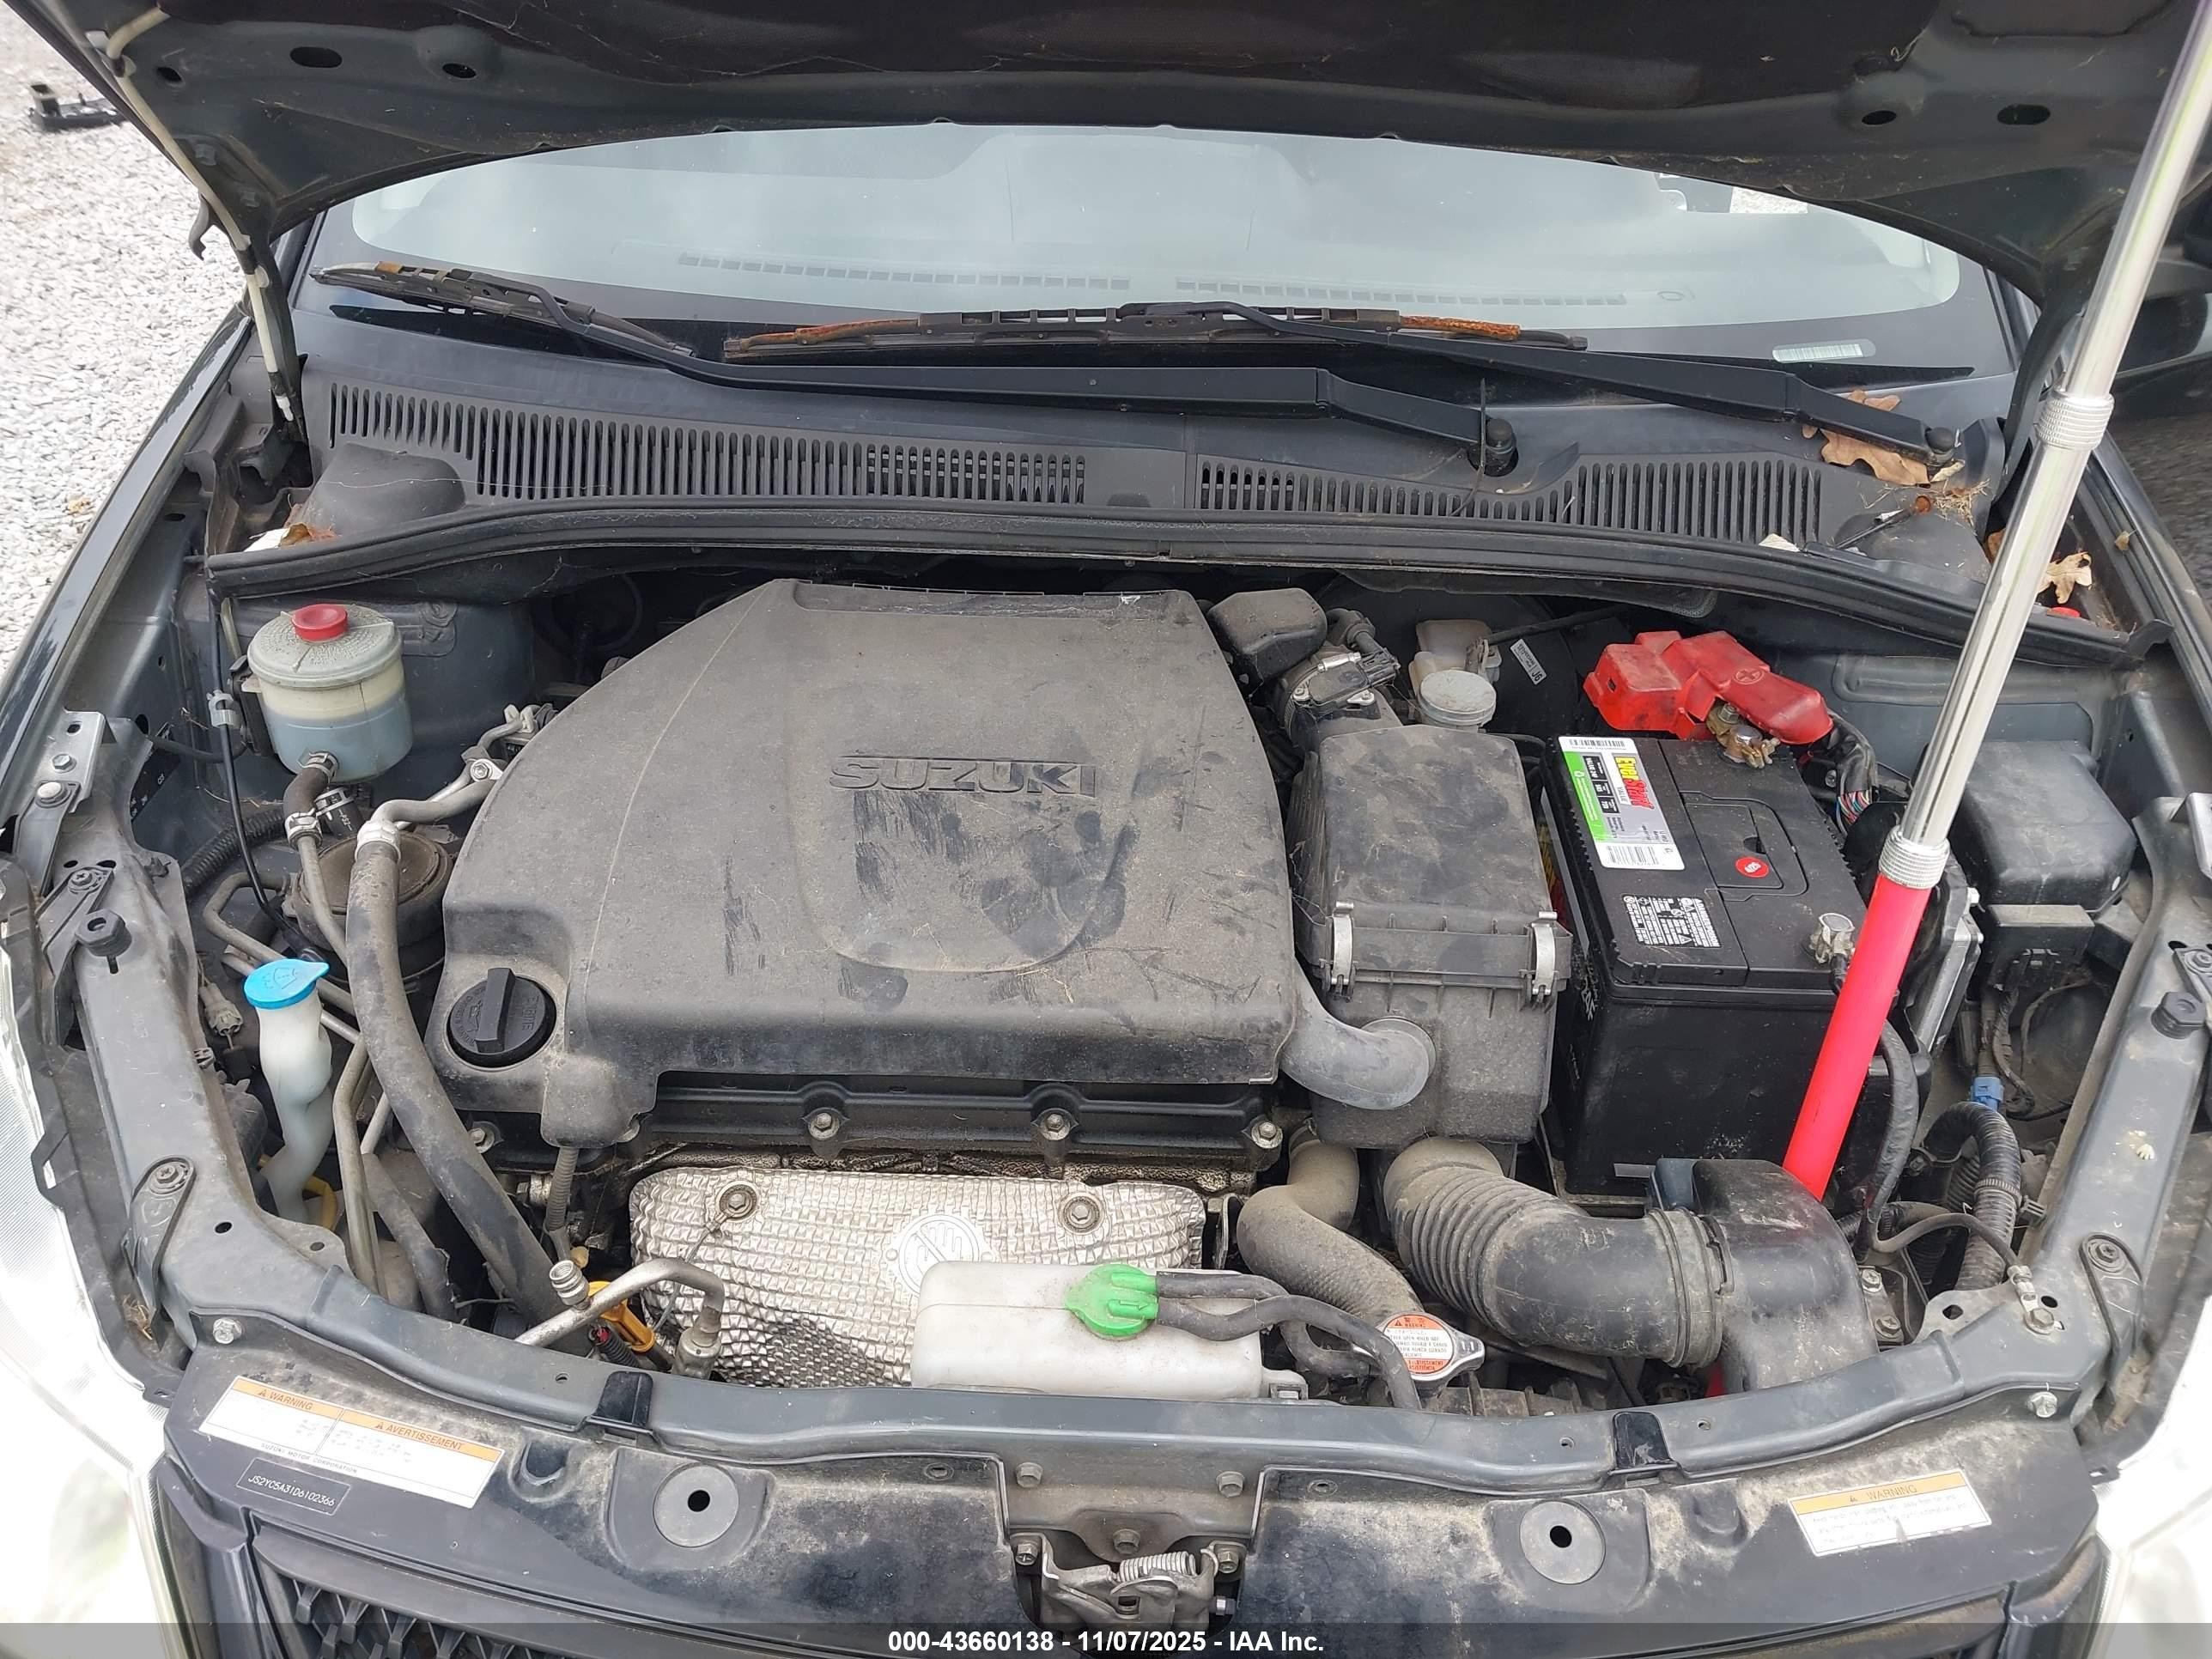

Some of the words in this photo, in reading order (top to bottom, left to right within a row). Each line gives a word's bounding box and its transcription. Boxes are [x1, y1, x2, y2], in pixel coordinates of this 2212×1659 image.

[830, 755, 1096, 798] SUZUKI
[268, 1391, 313, 1411] WARNING
[386, 1424, 464, 1451] AVERTISSEMENT
[288, 1450, 310, 1461] MOTOR
[247, 1475, 336, 1507] JS2YC5A31D6102366
[1865, 1485, 1917, 1501] WARNING
